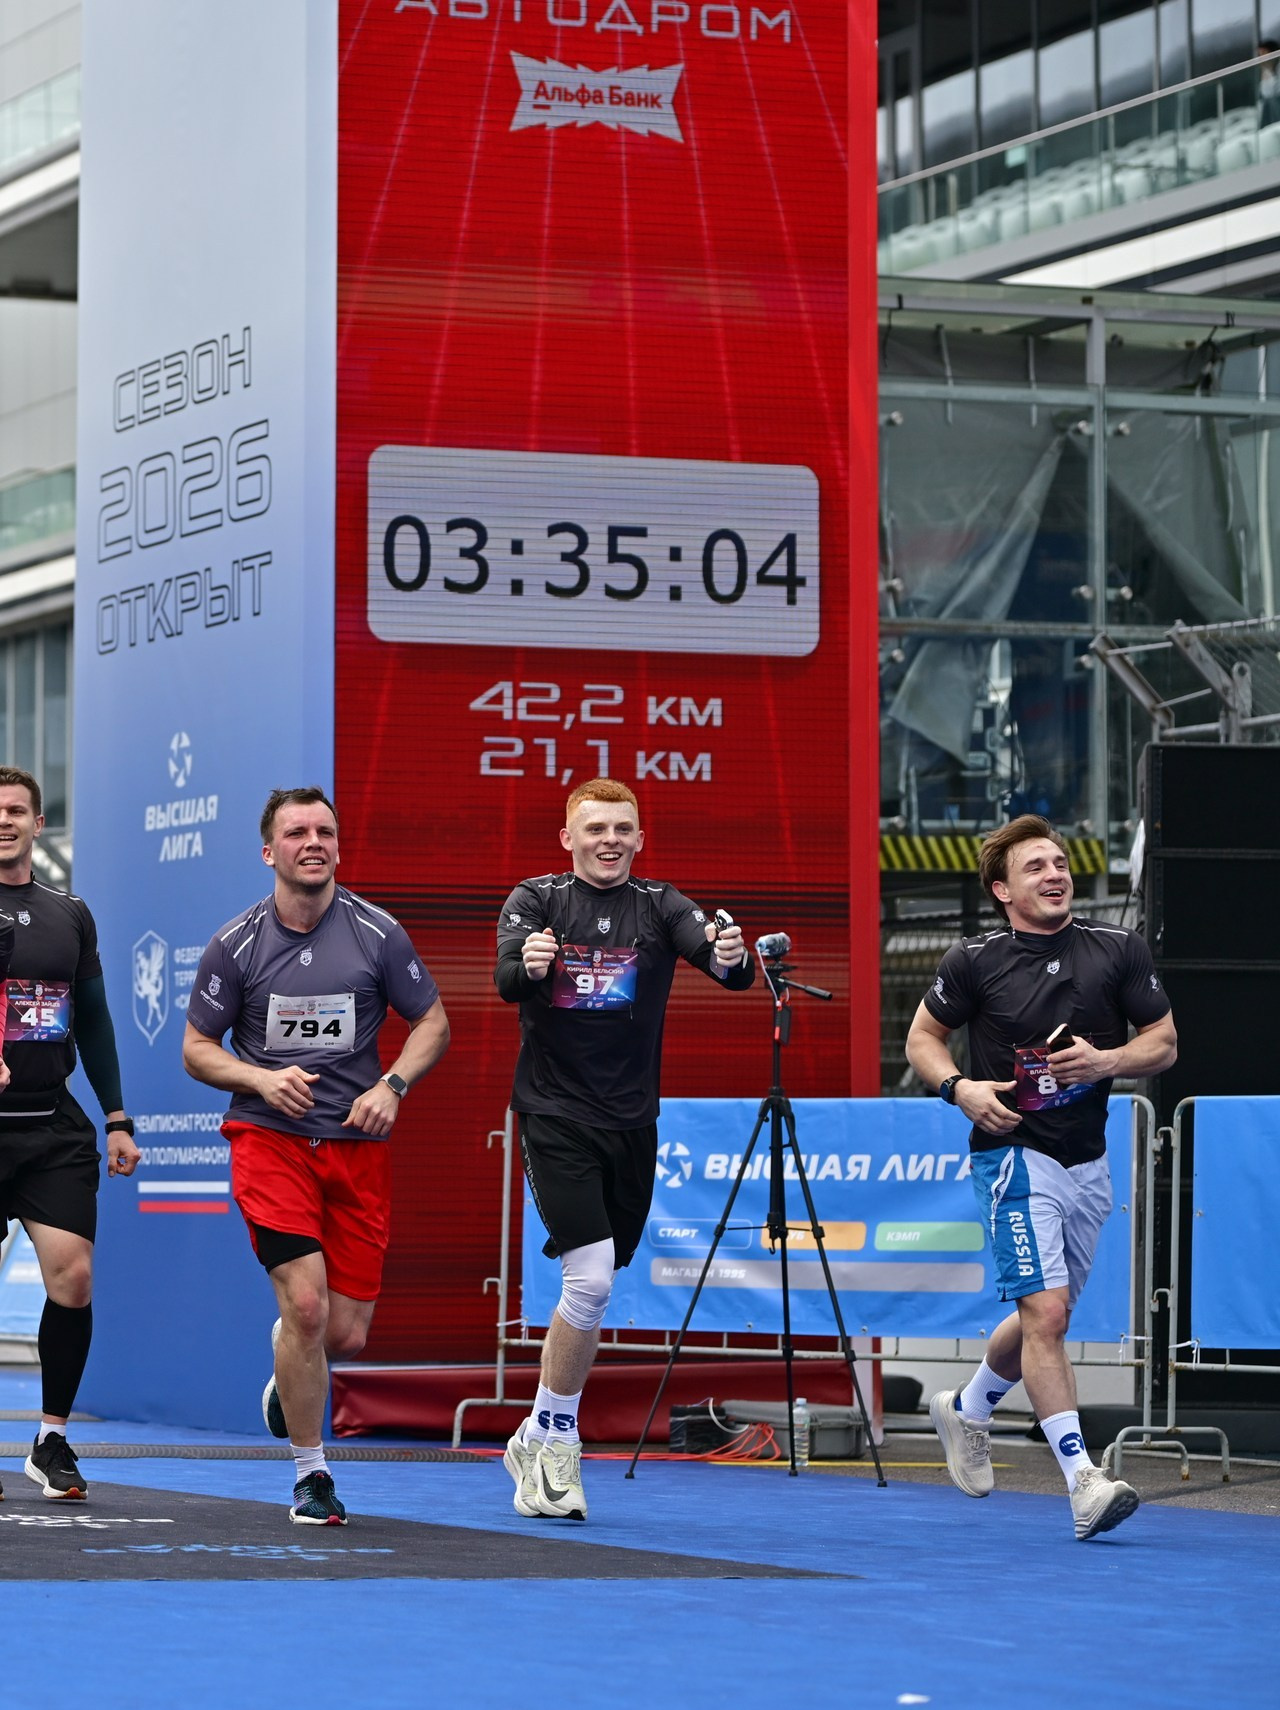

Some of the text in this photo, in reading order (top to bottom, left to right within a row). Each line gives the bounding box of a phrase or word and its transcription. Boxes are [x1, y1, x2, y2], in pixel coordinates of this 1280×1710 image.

[533, 80, 663, 109] Альфа Банк
[113, 326, 251, 433] СЕЗОН
[98, 418, 272, 564] 2026
[383, 515, 806, 605] 03:35:04
[97, 551, 272, 656] ОТКРЫТ
[469, 681, 624, 730] 42,2
[480, 736, 609, 786] 21,1
[144, 794, 219, 831] ВЫСШАЯ
[158, 831, 204, 862] ЛИГА
[576, 974, 615, 995] 97
[593, 967, 624, 975] БЕЛЬСКИЙ
[20, 1007, 56, 1027] 45
[280, 1019, 342, 1038] 794
[134, 1114, 195, 1133] ЧЕМПИОНАТ
[152, 1146, 231, 1166] ПОЛУМАРАФОНУ
[658, 1228, 698, 1239] СТАРТ
[886, 1231, 921, 1242] КЭМП
[1008, 1211, 1034, 1276] RUSSIA
[661, 1267, 714, 1278] МАГАЗН
